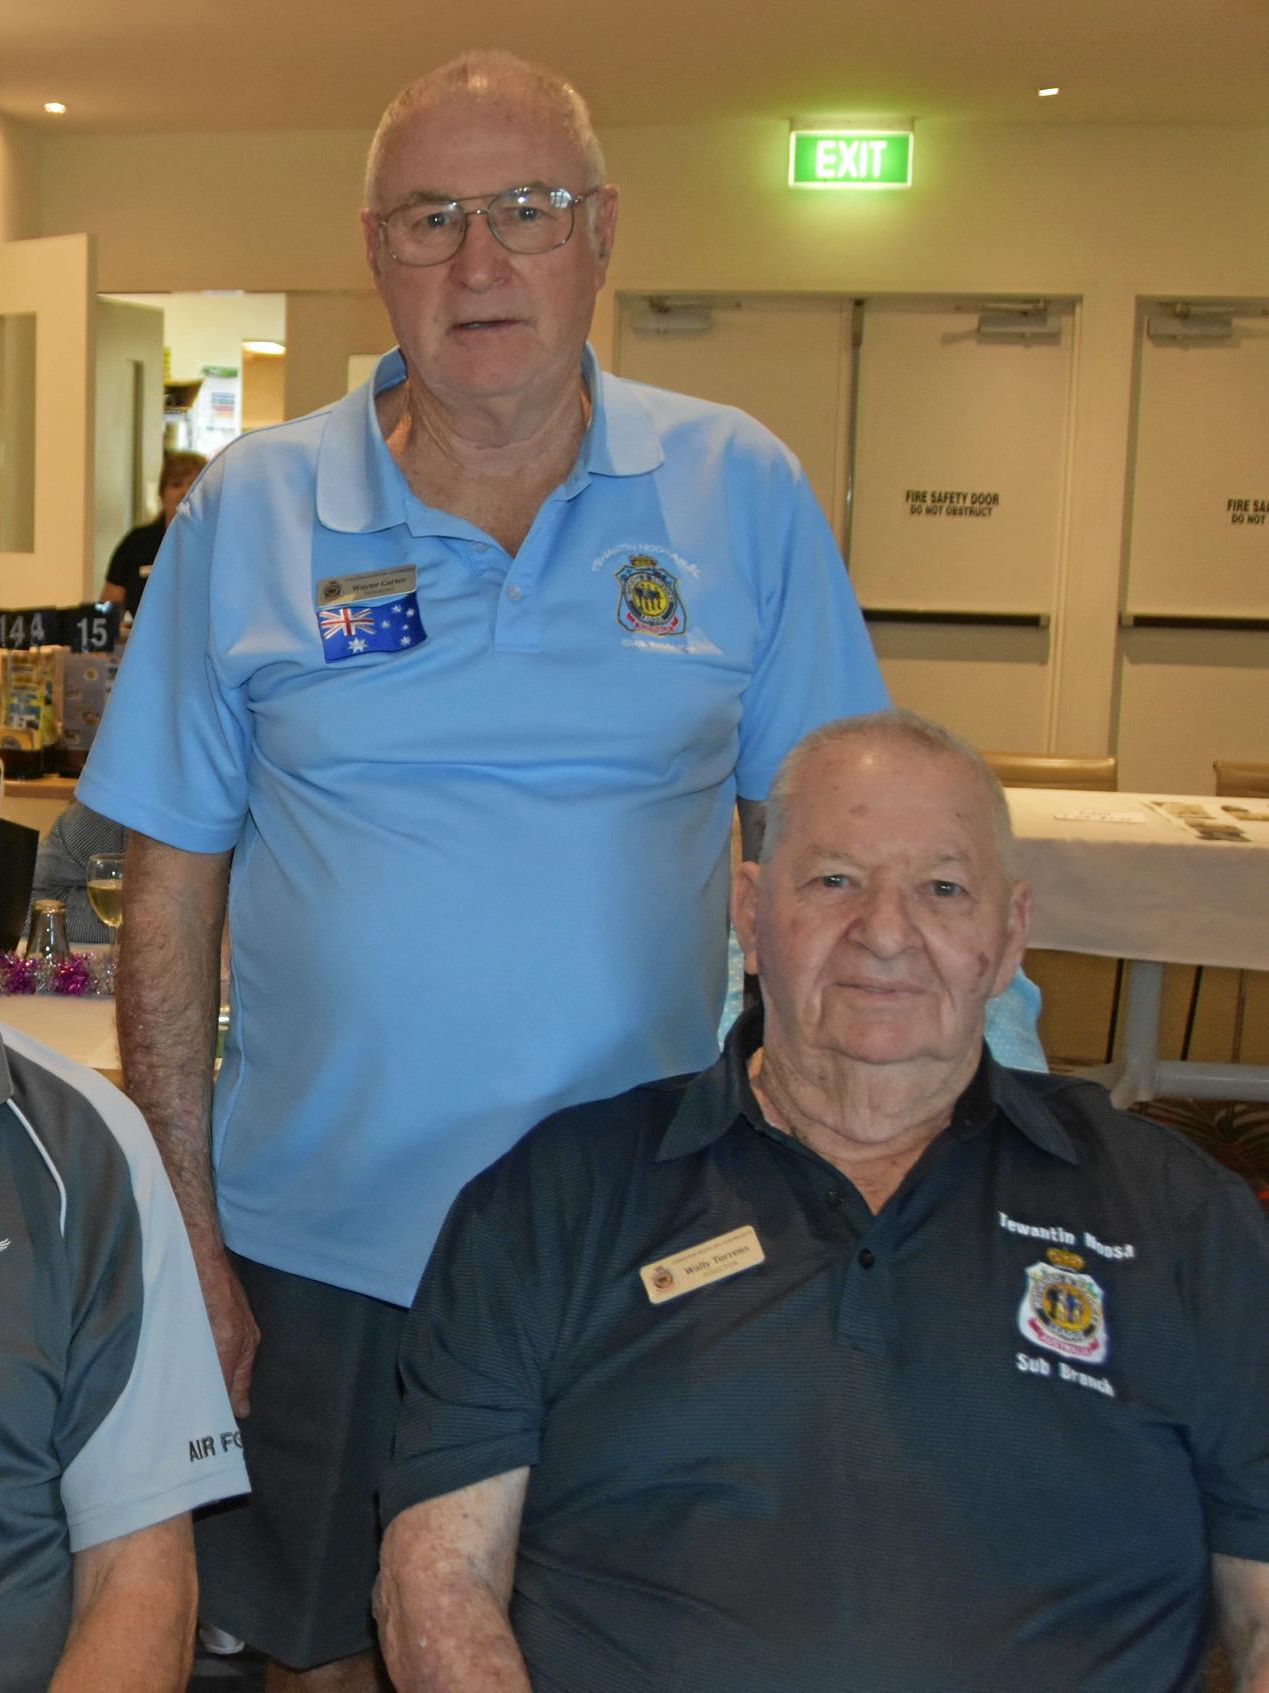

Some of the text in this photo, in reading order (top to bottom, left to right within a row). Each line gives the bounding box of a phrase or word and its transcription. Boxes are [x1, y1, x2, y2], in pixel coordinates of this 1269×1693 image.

[816, 140, 888, 179] EXIT
[906, 490, 1000, 505] FIRE SAFETY DOOR
[1227, 498, 1269, 512] FIRE SA
[910, 504, 993, 517] DO NOT OBSTRUCT
[1231, 512, 1266, 525] DO NOT
[352, 581, 379, 593] Wayne
[77, 617, 108, 649] 15
[998, 1210, 1135, 1259] Tewantin Noosa
[682, 1260, 711, 1275] Wally
[1016, 1352, 1116, 1397] Sub Branch
[188, 1435, 216, 1463] AIR
